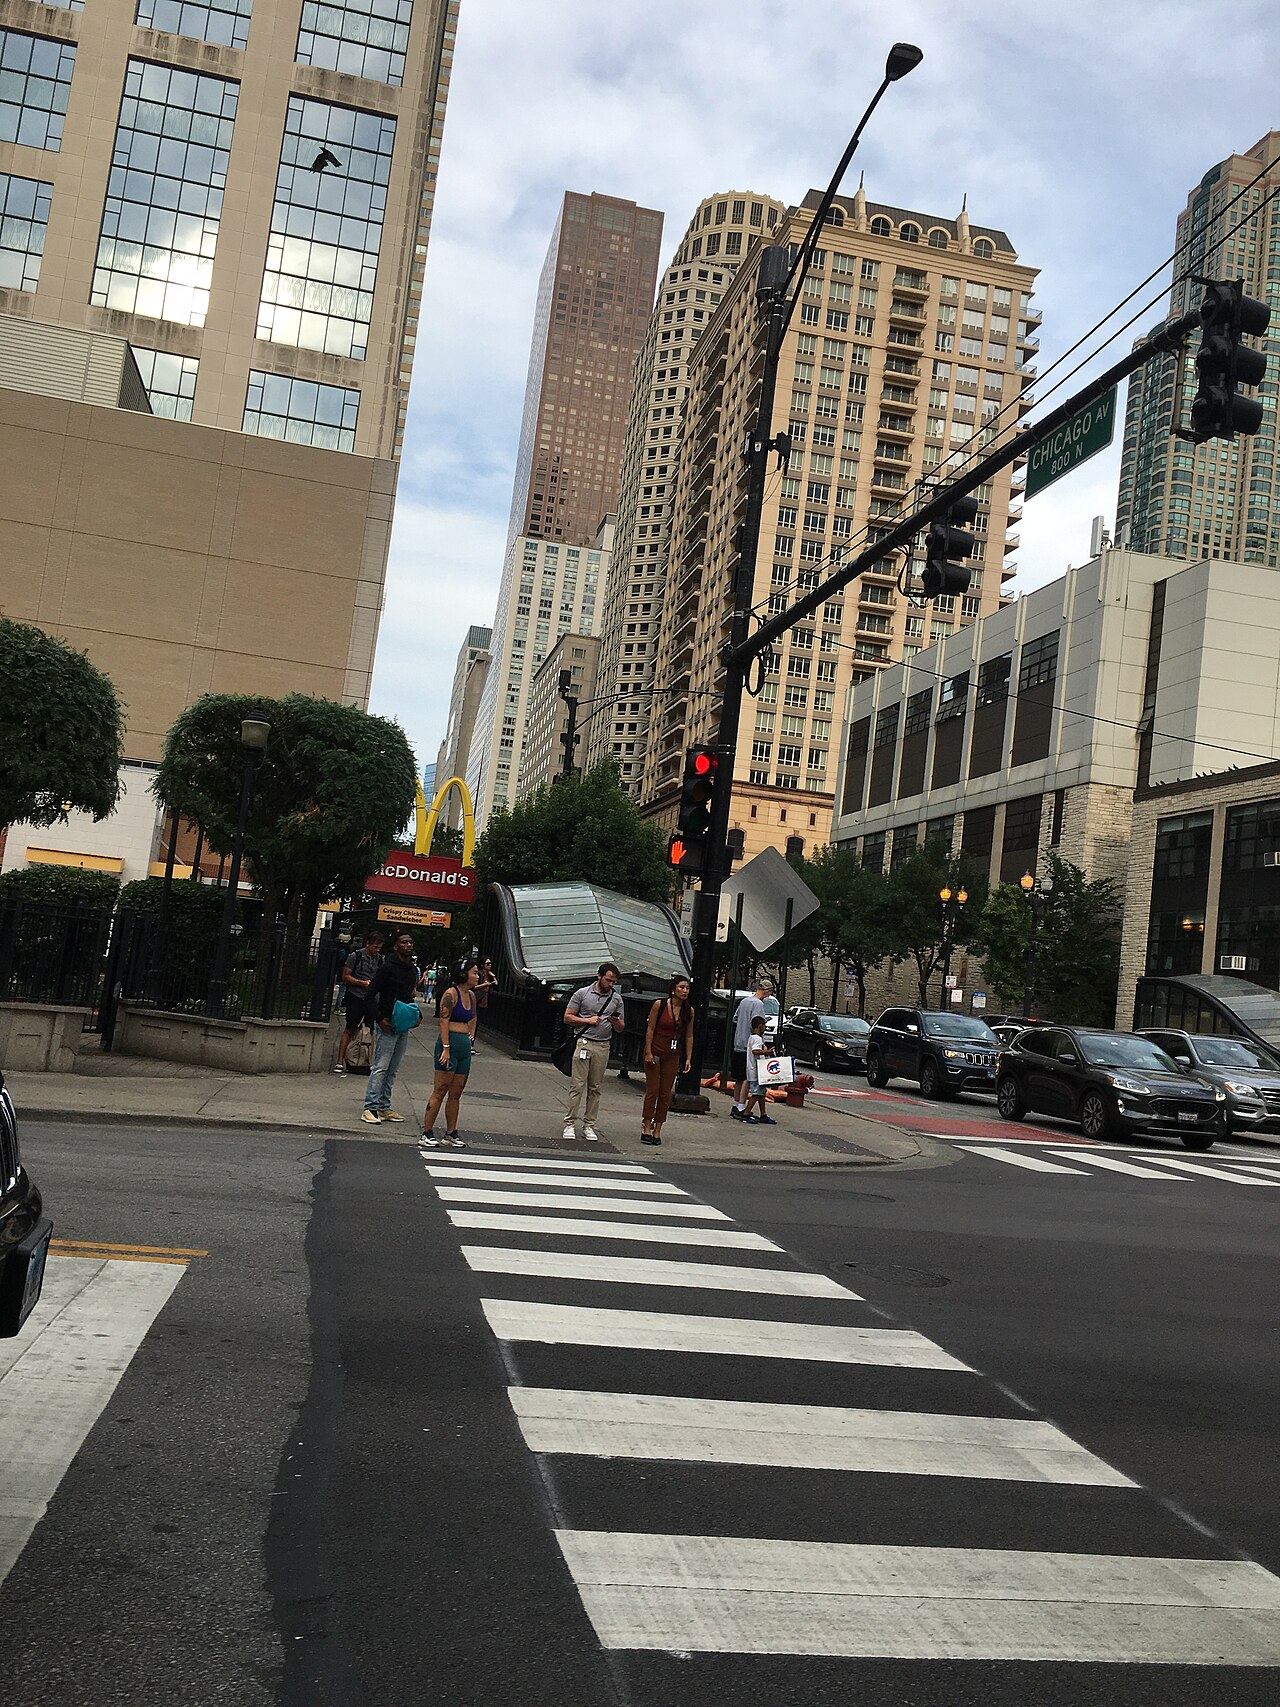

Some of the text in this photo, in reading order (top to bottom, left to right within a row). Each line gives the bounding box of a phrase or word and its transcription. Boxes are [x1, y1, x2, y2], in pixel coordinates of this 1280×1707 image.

[1032, 401, 1110, 470] CHICAGO AV
[1050, 442, 1083, 475] 800 N
[383, 907, 402, 916] Crispy
[403, 910, 428, 918] Chicken
[386, 914, 422, 924] Sandwiches
